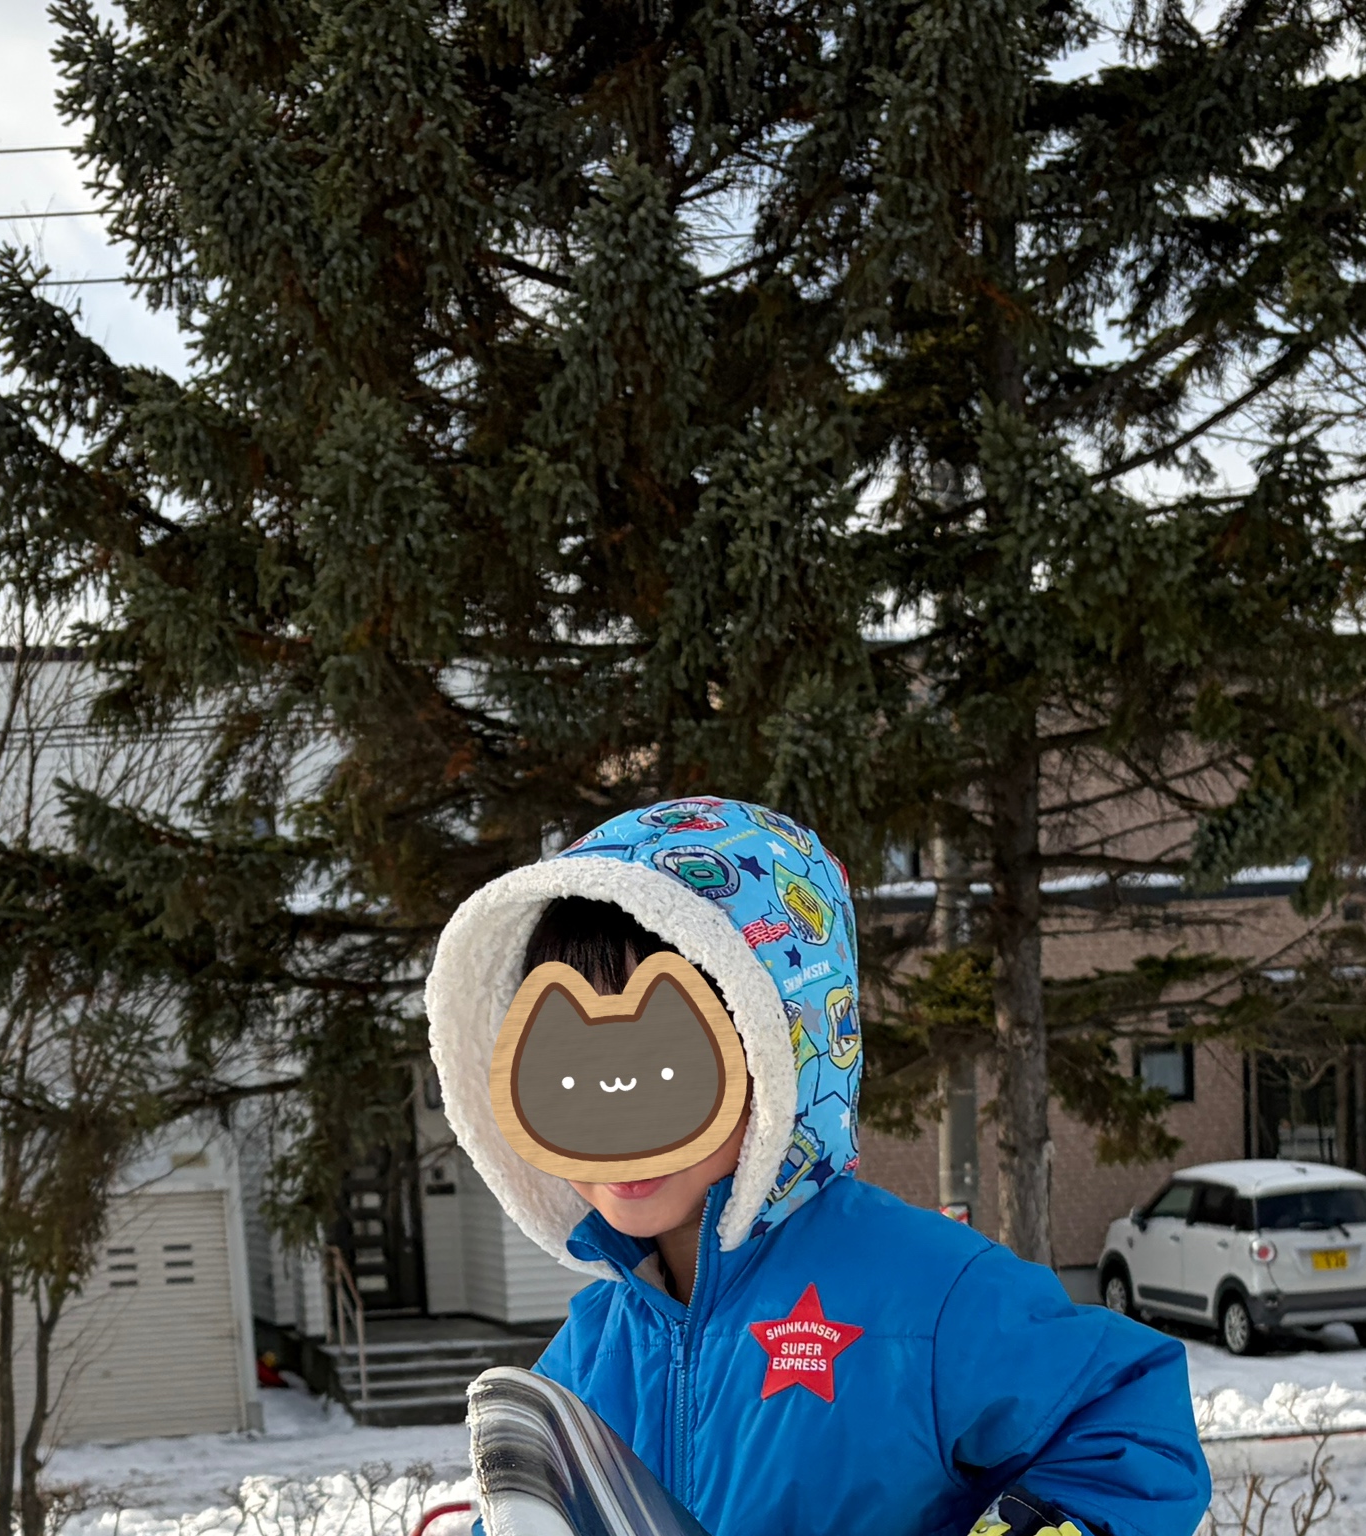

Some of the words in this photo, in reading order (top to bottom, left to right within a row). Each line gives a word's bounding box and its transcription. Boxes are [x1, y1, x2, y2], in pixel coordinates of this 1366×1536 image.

[766, 1321, 841, 1343] SHINKANSEN
[781, 1342, 822, 1356] SUPER
[772, 1357, 827, 1371] EXPRESS
